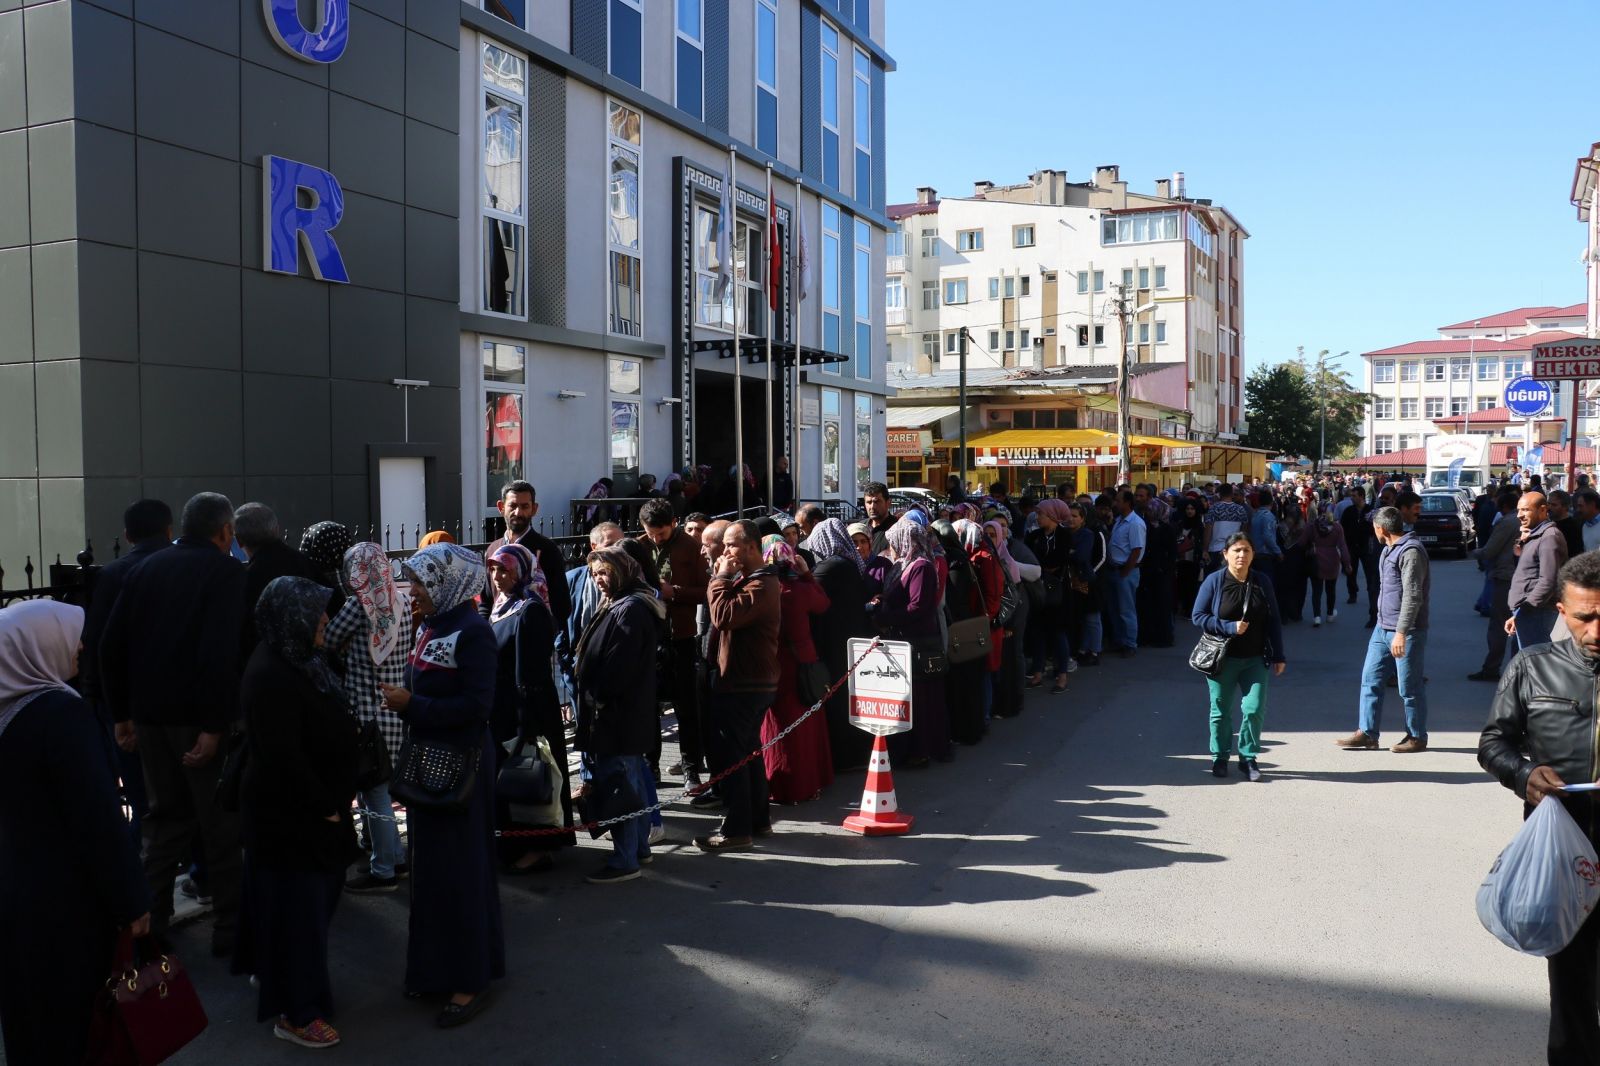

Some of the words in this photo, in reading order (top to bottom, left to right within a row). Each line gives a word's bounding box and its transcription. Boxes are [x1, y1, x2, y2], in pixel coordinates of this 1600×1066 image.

[1508, 389, 1547, 402] UĞUR
[998, 448, 1039, 459] EVKUR
[1043, 447, 1097, 459] TİCARET
[855, 700, 877, 715] PARK
[878, 702, 906, 718] YASAK
